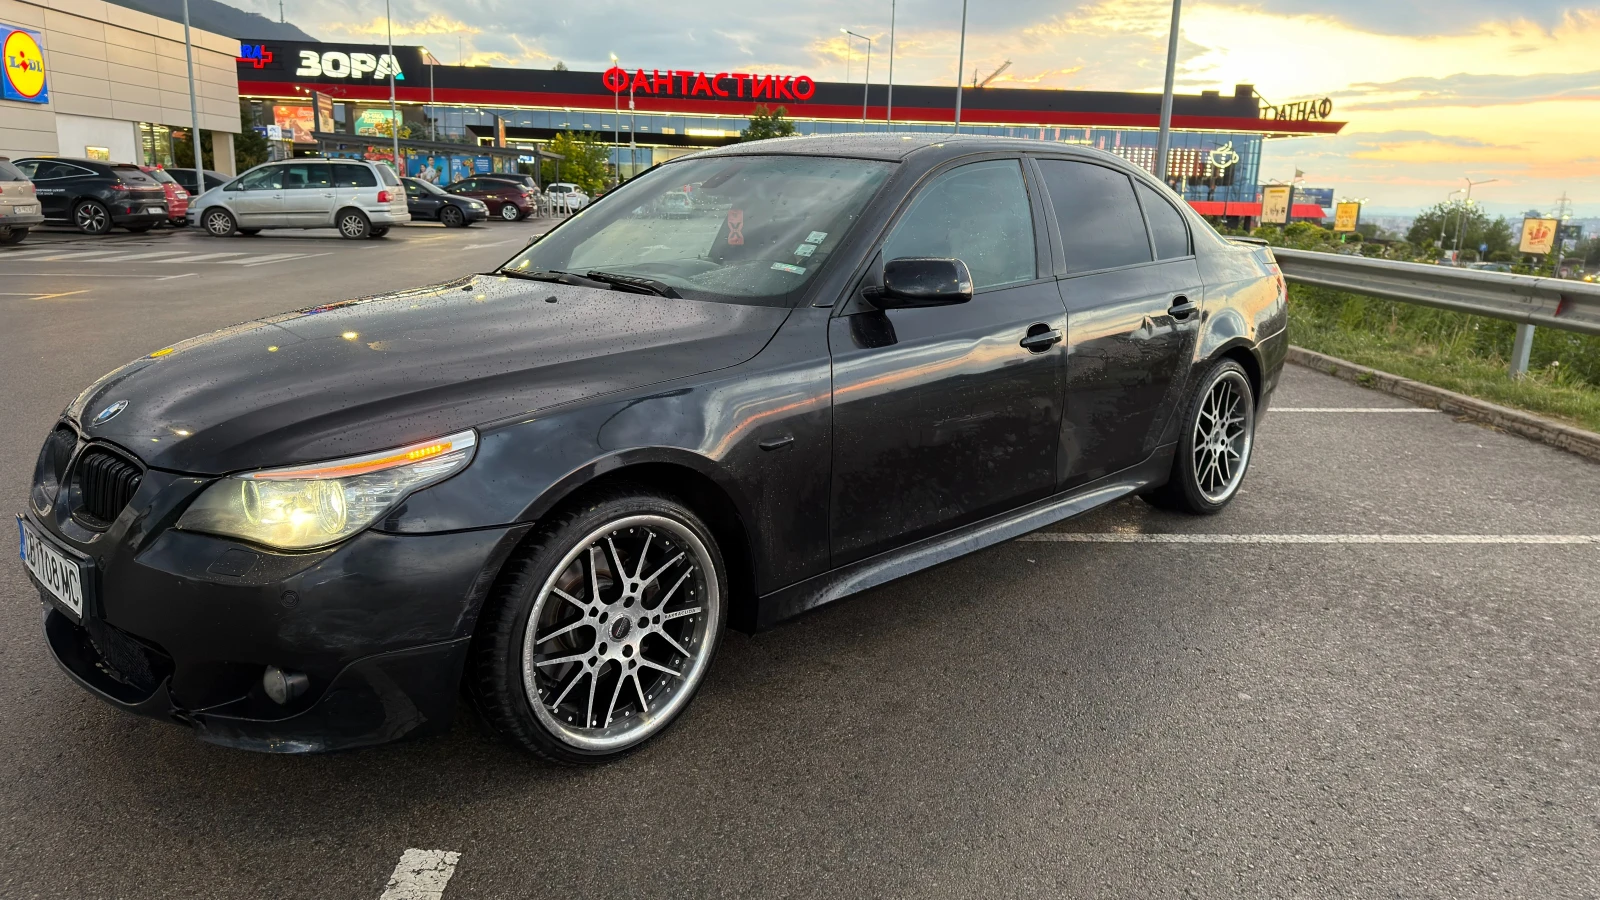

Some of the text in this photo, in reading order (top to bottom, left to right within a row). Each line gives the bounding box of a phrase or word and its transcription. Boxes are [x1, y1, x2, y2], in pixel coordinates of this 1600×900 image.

[8, 51, 43, 73] LIDL
[241, 45, 262, 59] RA
[296, 50, 405, 80] ЗОРА
[602, 66, 816, 100] ФАНТАСТИКО
